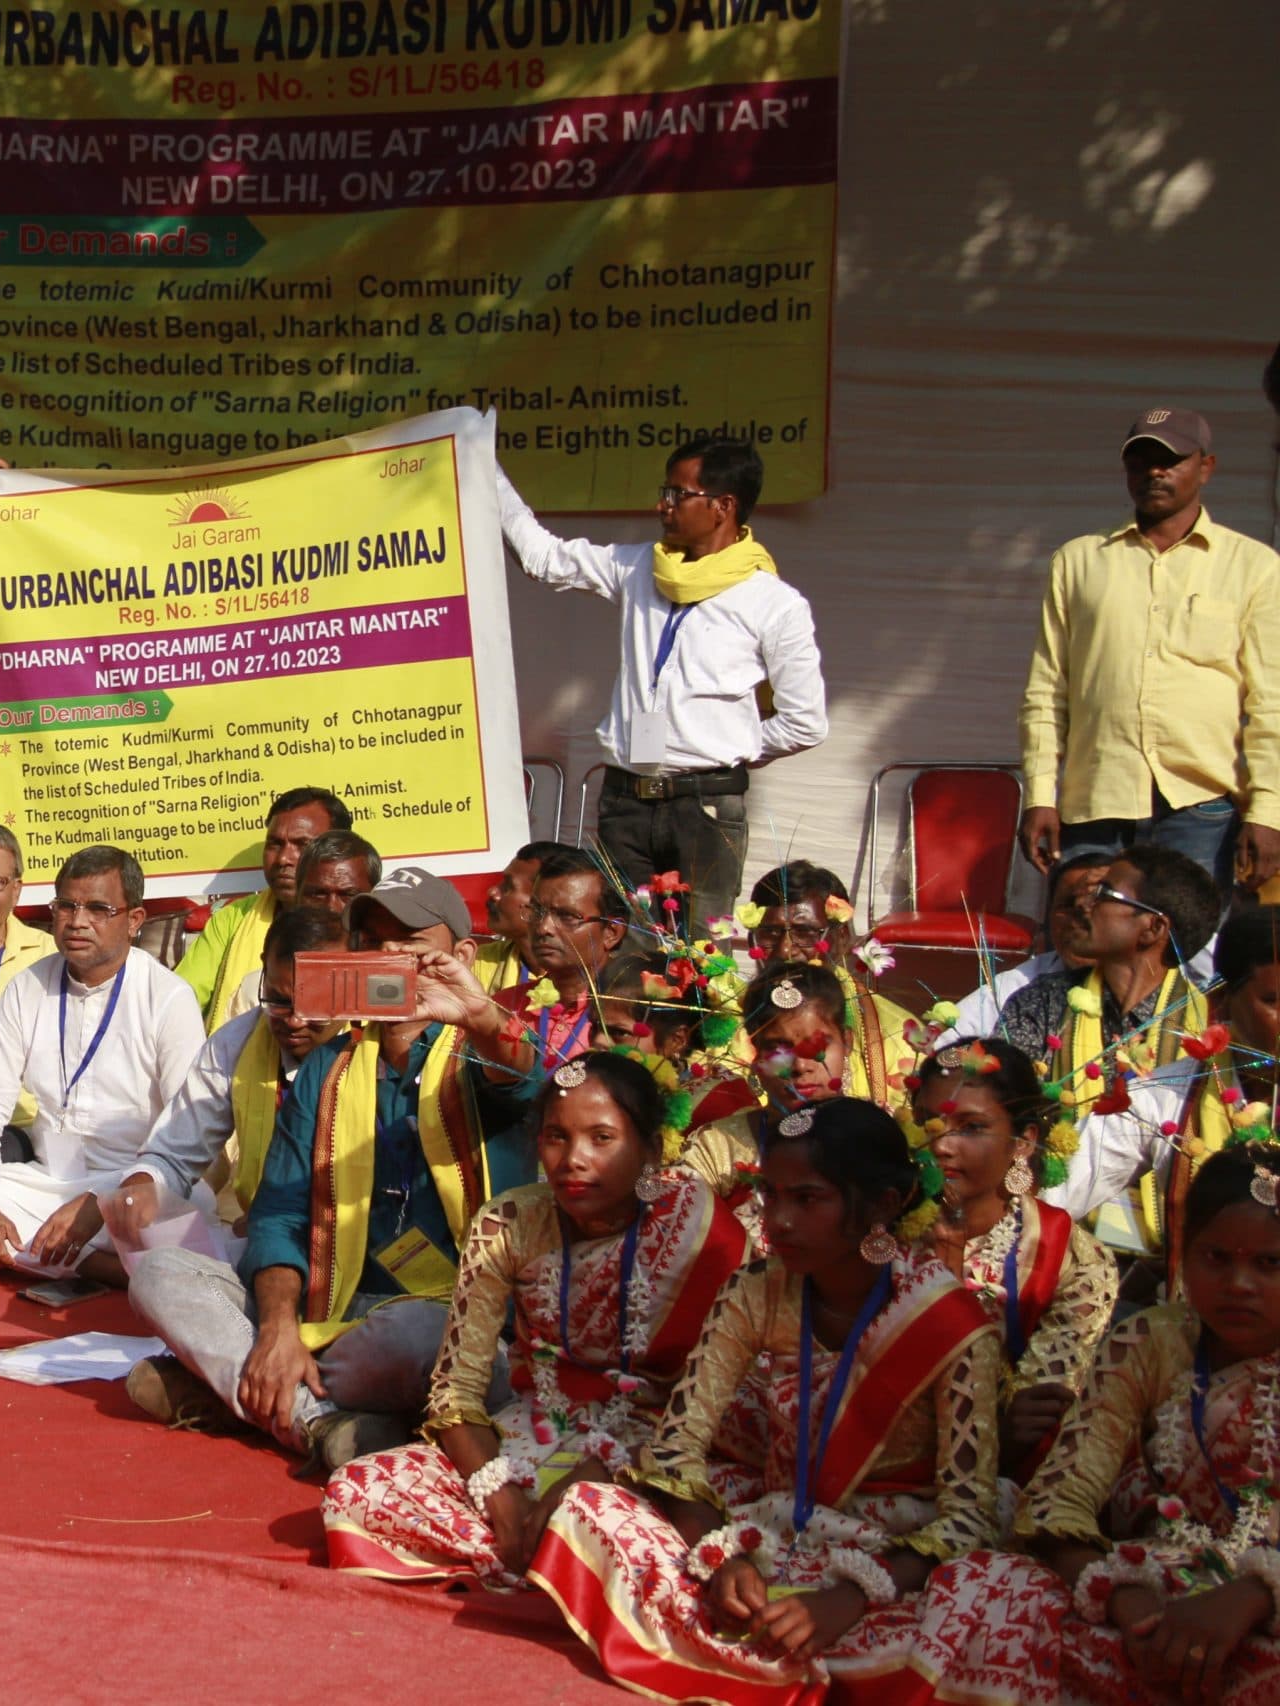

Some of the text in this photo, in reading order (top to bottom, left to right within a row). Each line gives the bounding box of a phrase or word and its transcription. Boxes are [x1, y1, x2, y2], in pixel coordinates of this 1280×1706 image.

[254, 0, 446, 63] ADIBASI
[465, 0, 631, 50] KUDMI
[172, 74, 246, 110] Reg.
[257, 72, 313, 100] No.
[348, 57, 545, 98] S/1L/56418
[128, 130, 372, 163] PROGRAMME
[382, 129, 431, 158] AT
[442, 112, 609, 154] "JANTAR
[622, 97, 809, 142] MANTAR"
[122, 158, 598, 207] NEW DELHI, ON 27.10.2023
[20, 225, 210, 257] Demands
[40, 278, 134, 301] totemic
[157, 276, 332, 301] Kudmi/Kurmi
[358, 271, 521, 300] Community
[545, 266, 574, 291] of
[599, 258, 815, 290] Chhotanagpur
[85, 315, 158, 343] (West
[165, 316, 266, 344] Bengal,
[273, 312, 420, 338] Jharkhand
[428, 313, 447, 336] &
[455, 307, 562, 336] Odisha)
[570, 307, 599, 329] to
[606, 305, 642, 328] be
[650, 299, 778, 327] included
[786, 297, 812, 321] in
[11, 352, 50, 374] list
[55, 352, 81, 374] of
[85, 352, 222, 377] Scheduled
[230, 353, 312, 376] Tribes
[317, 352, 345, 375] of
[350, 351, 422, 375] India.
[19, 388, 164, 418] recognition
[169, 390, 198, 413] of
[202, 390, 292, 414] "Sarna
[297, 389, 421, 418] Religion"
[426, 388, 466, 411] for
[19, 424, 122, 449] Kudmali
[128, 427, 248, 456] language
[253, 429, 280, 451] to
[290, 428, 318, 447] be
[495, 426, 528, 450] he
[535, 423, 630, 455] Eighth
[637, 420, 773, 447] Schedule
[781, 418, 808, 443] of
[379, 457, 427, 479] Johar
[172, 526, 261, 550] Jai Garam
[163, 553, 263, 597] ADIBASI
[272, 540, 349, 585] KUDMI
[357, 526, 446, 572] SAMAJ
[119, 604, 160, 626] Reg.
[166, 601, 197, 620] No.
[215, 587, 310, 616] S/1L/56418
[99, 634, 227, 663] PROGRAMME
[231, 630, 256, 650] AT
[260, 619, 345, 645] "JANTAR
[350, 606, 448, 635] MANTAR"
[95, 645, 342, 689] NEW DELHI, ON 27.10.2023
[20, 702, 462, 755] The totemic Kudmi/Kurmi Community of Chhotanagpur
[40, 699, 147, 724] Demands
[22, 725, 464, 777] Province (West Bengal, Jharkhand & Odisha) to be included in
[24, 769, 264, 800] the list of Scheduled Tribes of India.
[25, 779, 407, 826] The recognition of "Sarna Religion" fo l-Animist.
[27, 832, 52, 847] The
[55, 827, 110, 845] Kudmali
[113, 820, 178, 843] language
[181, 821, 195, 835] to
[198, 818, 215, 834] be
[219, 815, 269, 832] includ
[382, 799, 452, 818] Schedule
[456, 796, 472, 812] of
[27, 854, 49, 869] the
[131, 847, 188, 863] titution.
